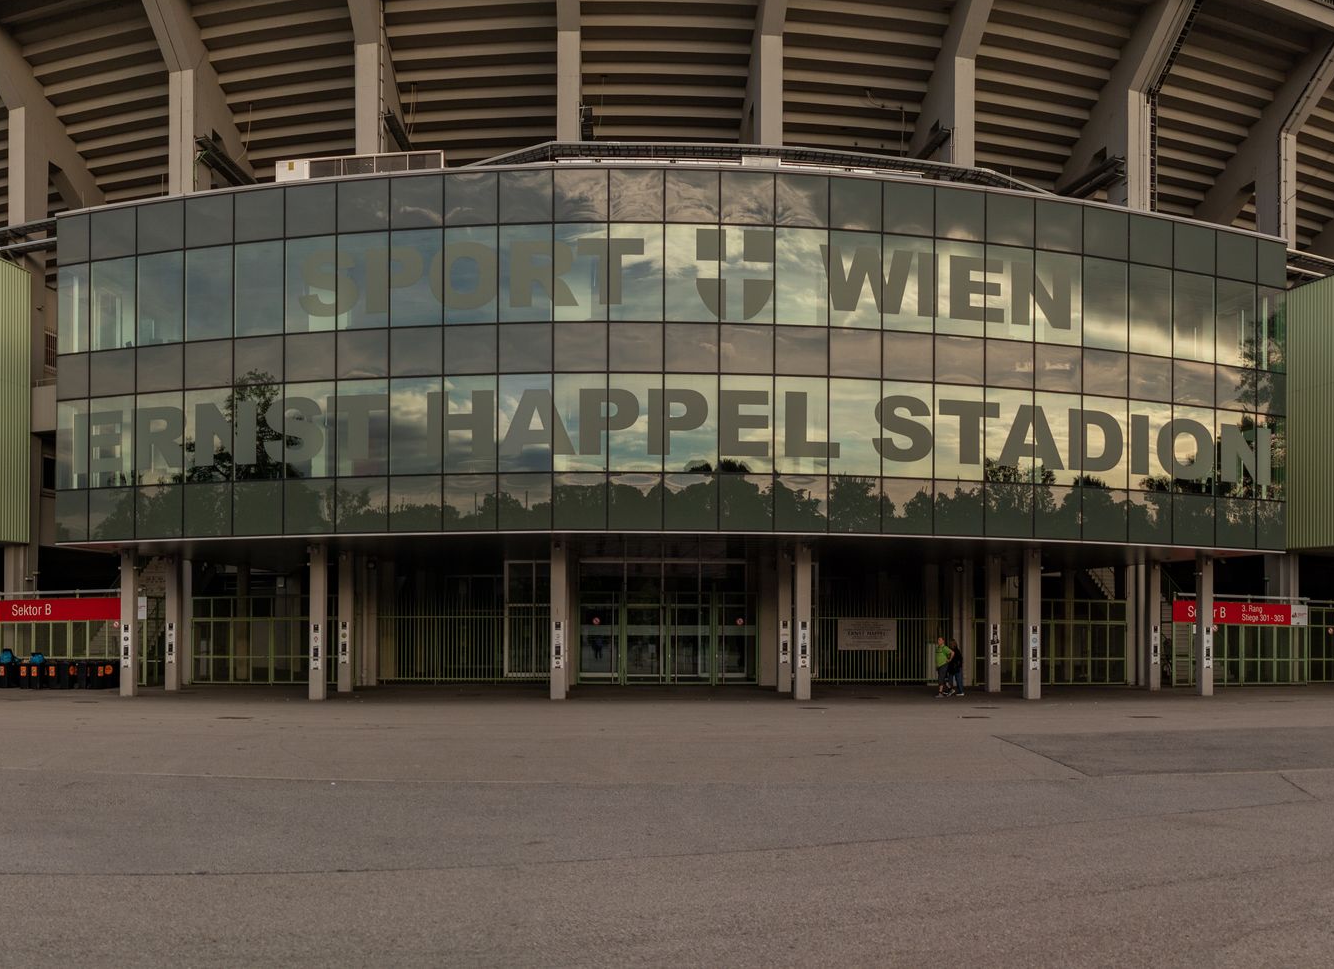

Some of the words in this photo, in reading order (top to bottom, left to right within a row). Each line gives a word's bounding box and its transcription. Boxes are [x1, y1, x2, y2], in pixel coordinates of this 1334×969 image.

[298, 237, 645, 318] SPORT
[820, 244, 1073, 331] WIEN
[72, 393, 390, 475] ERNST
[426, 389, 841, 459] HAPPEL
[872, 394, 1271, 486] STADION
[11, 604, 42, 617] Sektor
[45, 603, 52, 616] B
[1220, 606, 1226, 619] B
[1248, 604, 1263, 614] Rang
[1241, 613, 1259, 622] Stiege
